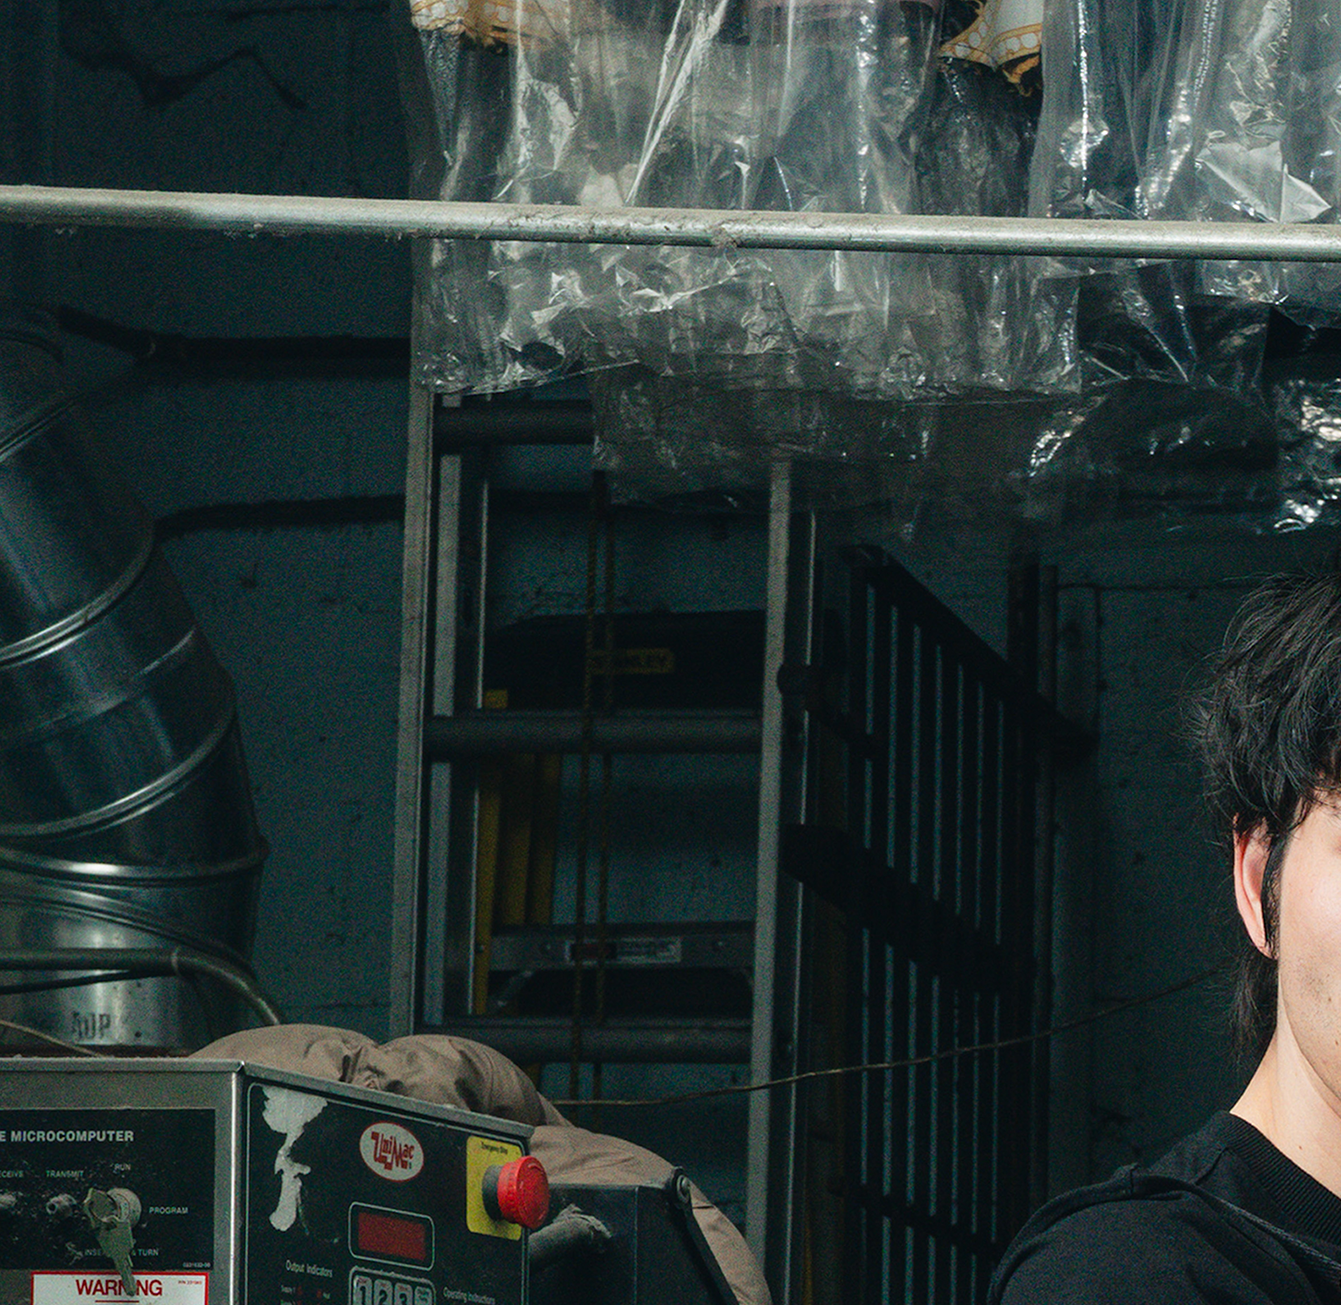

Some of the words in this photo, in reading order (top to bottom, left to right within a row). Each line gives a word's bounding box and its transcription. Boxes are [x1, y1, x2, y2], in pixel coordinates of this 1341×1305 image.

[10, 1130, 135, 1143] MICROCOMPUTER
[371, 1131, 415, 1171] UniMac
[114, 1163, 131, 1172] RUN
[46, 1170, 85, 1179] TRANSMIT
[149, 1206, 189, 1215] PROGRAM
[75, 1279, 163, 1296] WARNNG
